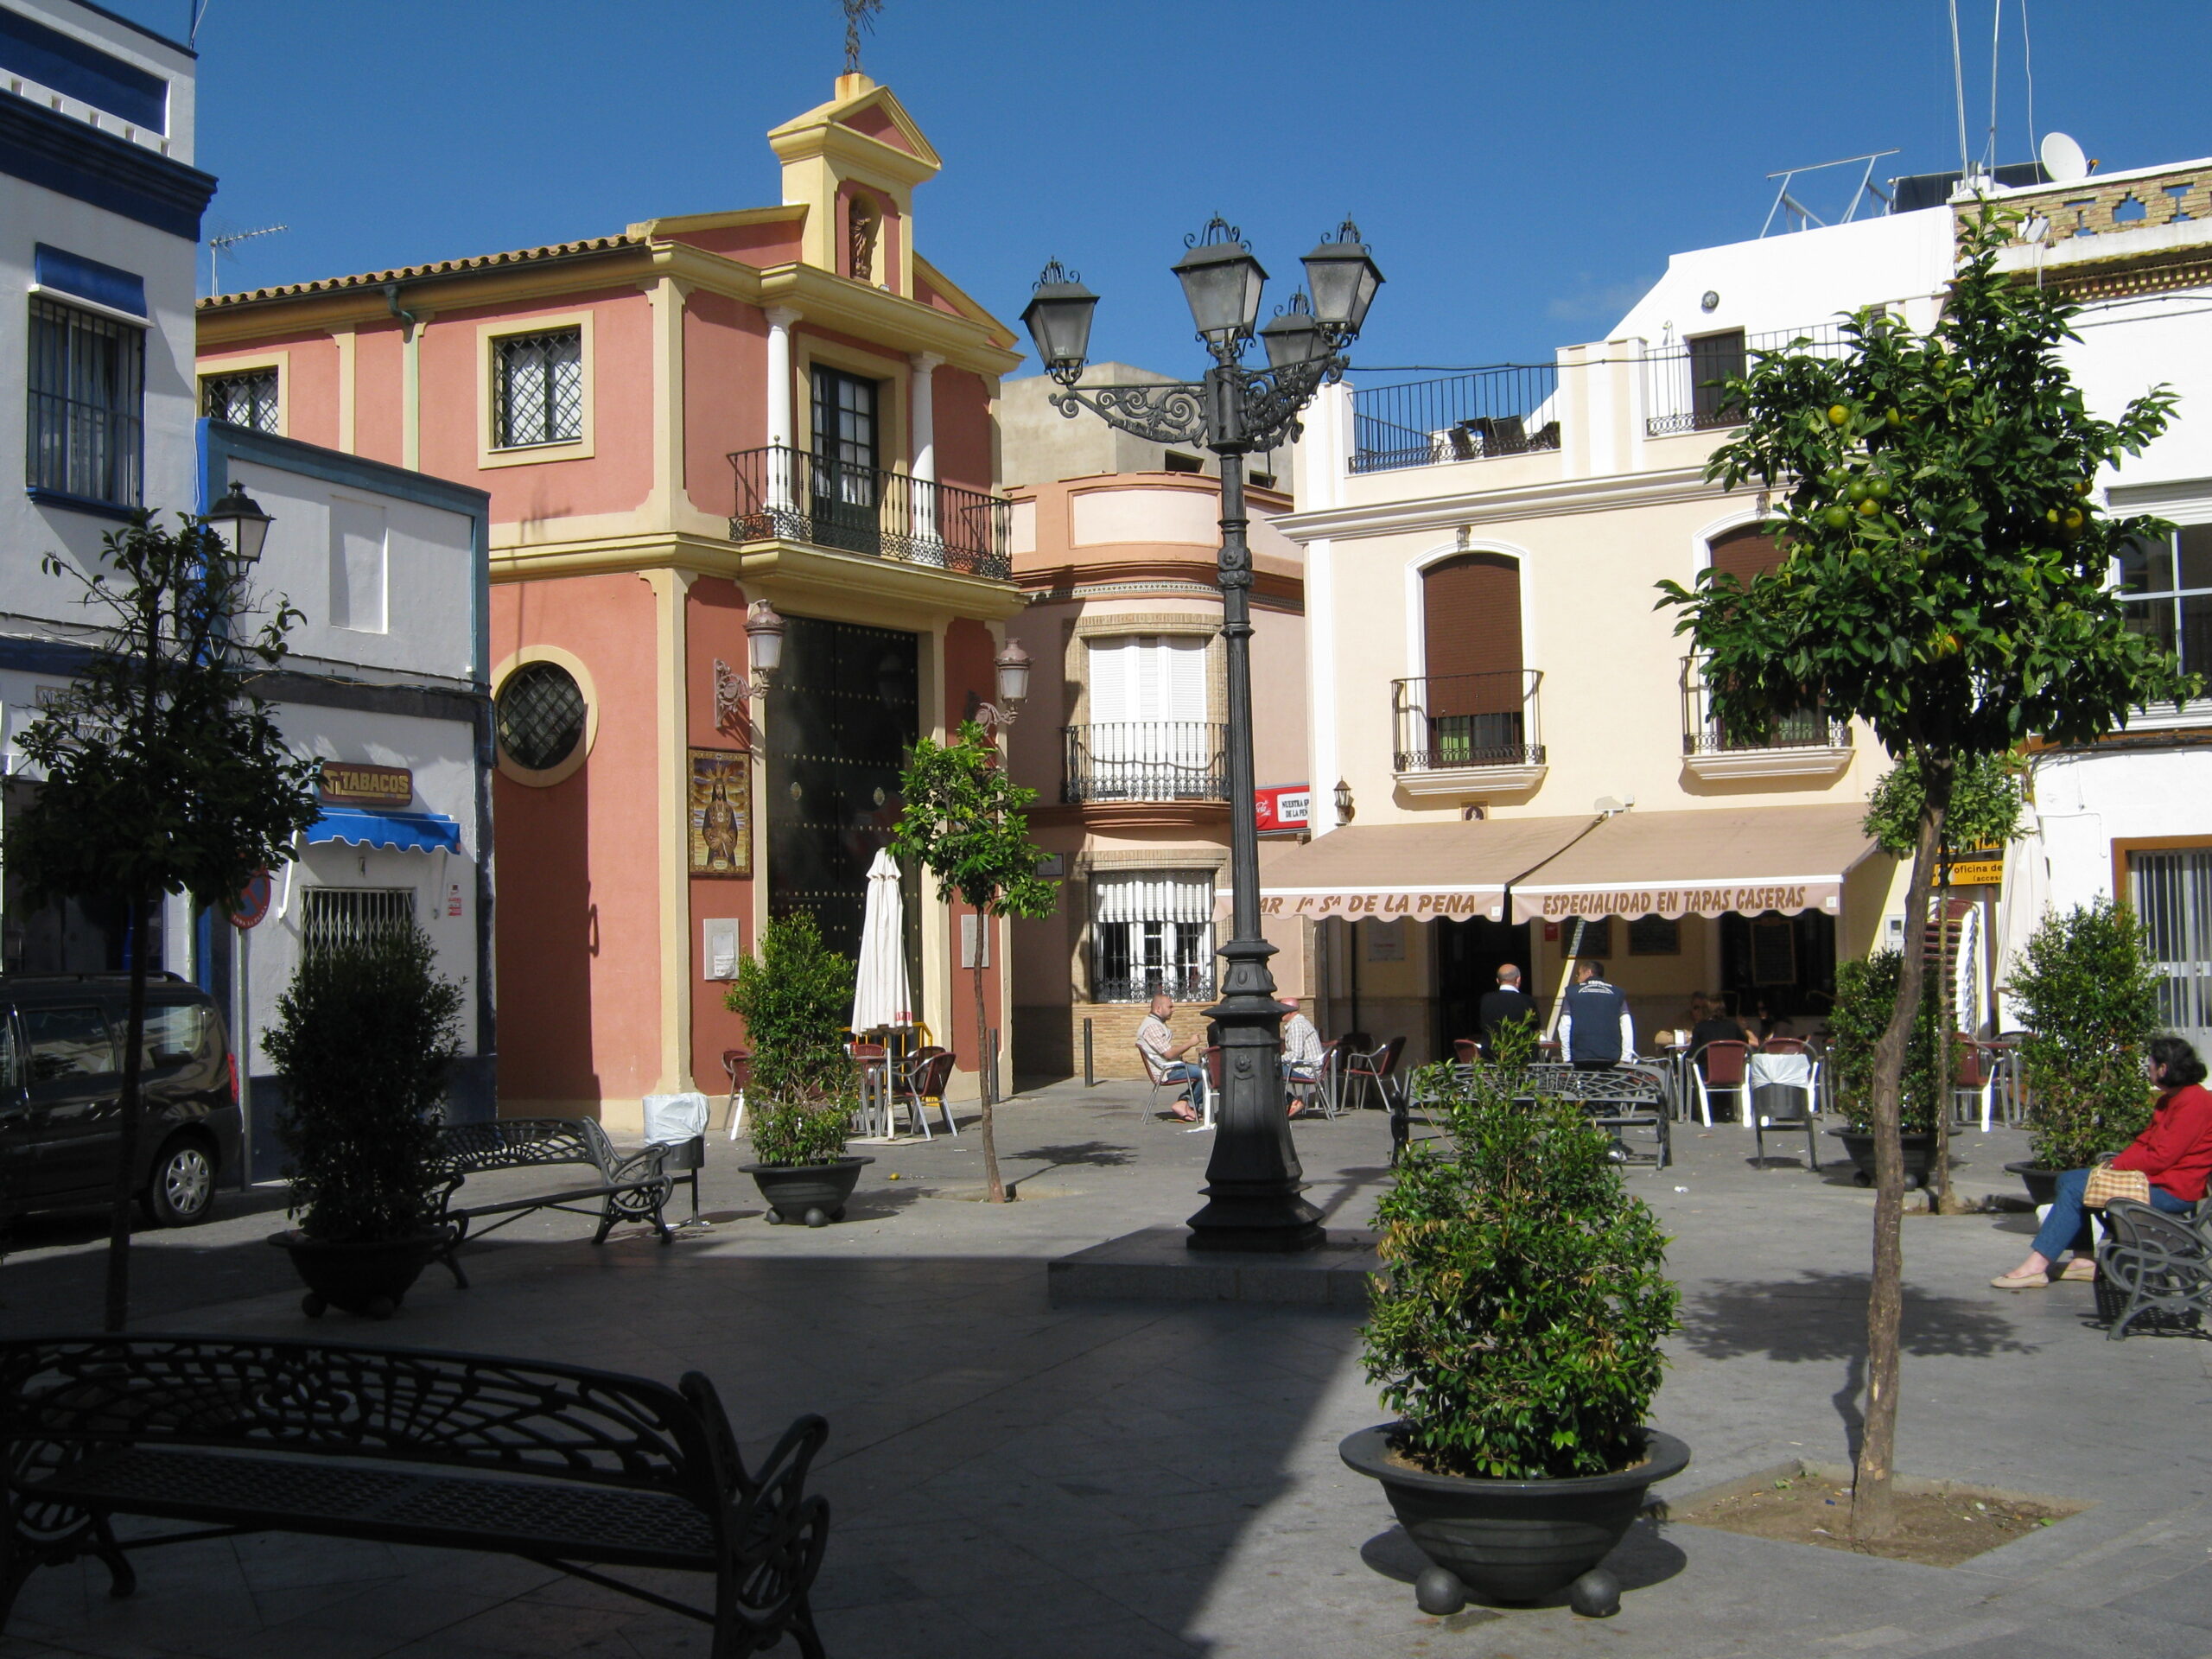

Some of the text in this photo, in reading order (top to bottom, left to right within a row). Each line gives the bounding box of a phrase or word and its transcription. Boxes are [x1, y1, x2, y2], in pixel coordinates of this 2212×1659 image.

[340, 771, 409, 793] TABACOS
[1281, 800, 1303, 809] NUESTRA
[1954, 863, 2002, 874] oficina de
[1261, 898, 1283, 913] AR
[1348, 895, 1378, 913] DE
[1384, 895, 1409, 913] LA
[1417, 893, 1475, 914] PEÑA
[1542, 887, 1807, 915] ESPECIALIDAD EN TAPAS CASERAS
